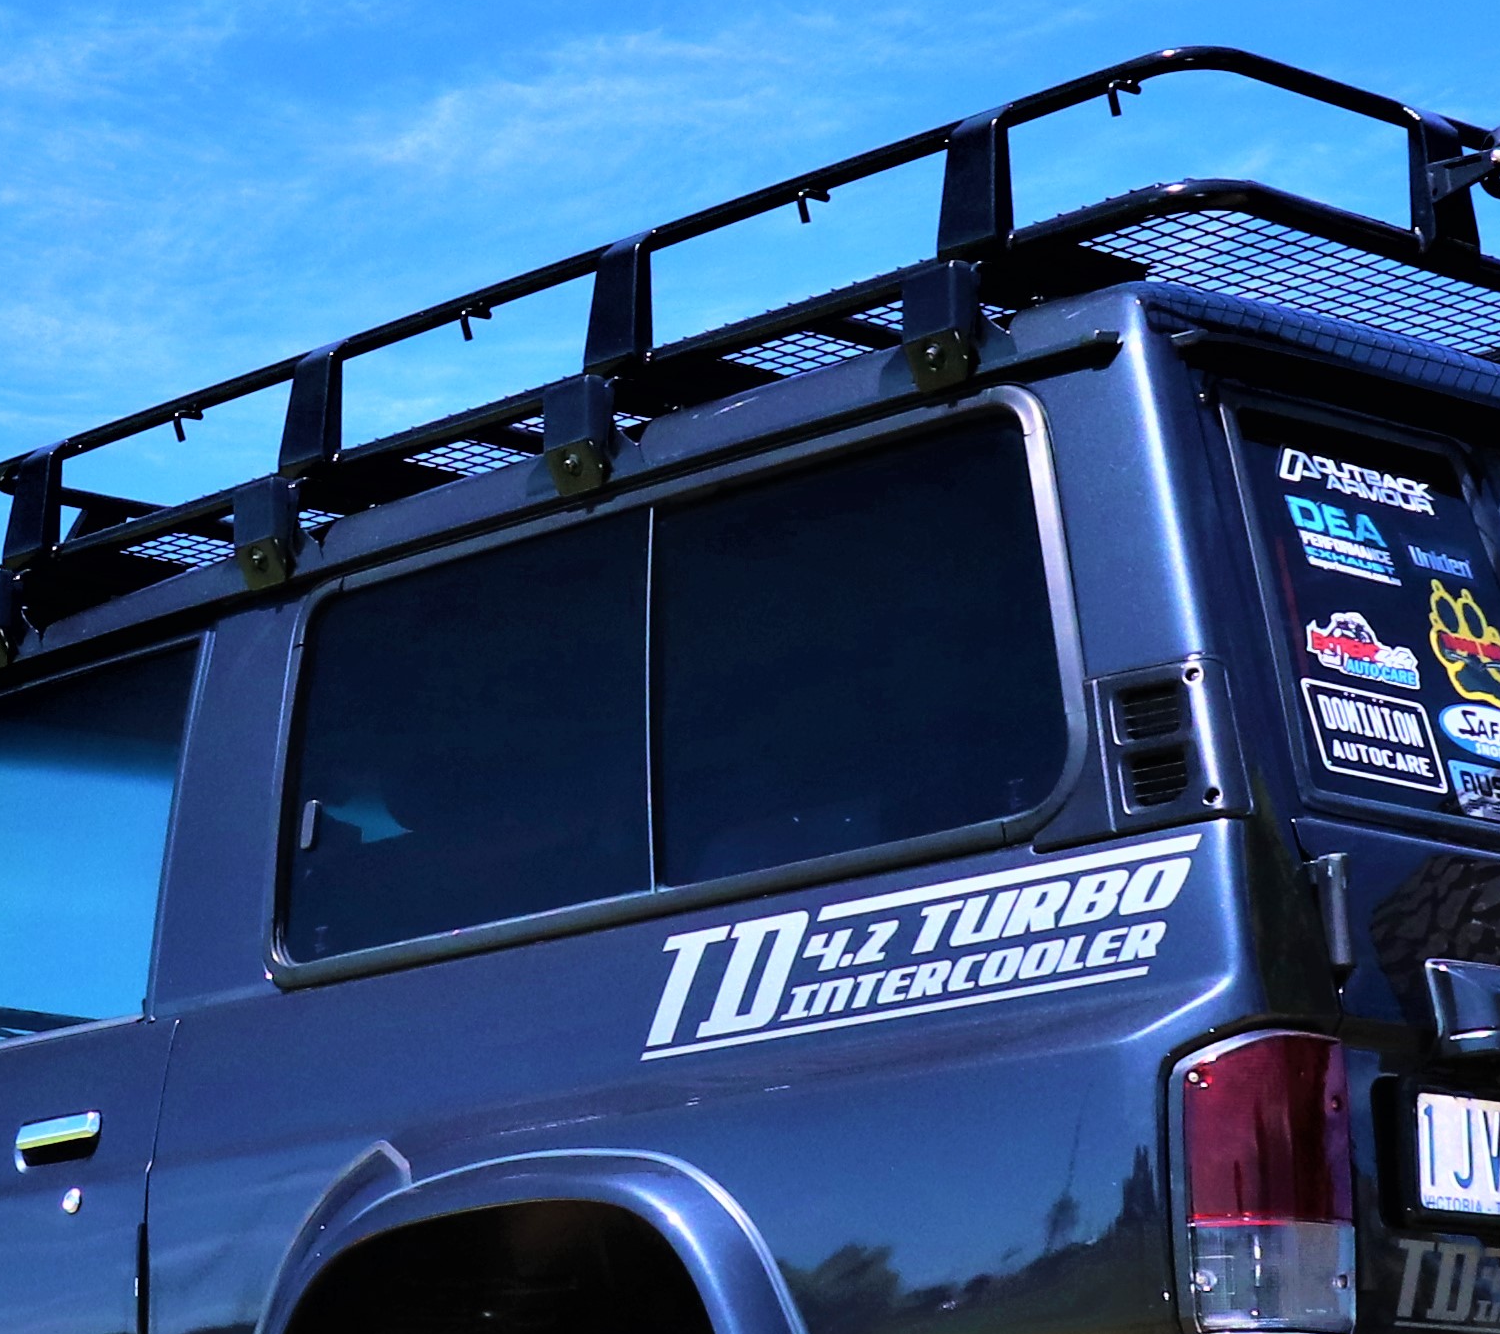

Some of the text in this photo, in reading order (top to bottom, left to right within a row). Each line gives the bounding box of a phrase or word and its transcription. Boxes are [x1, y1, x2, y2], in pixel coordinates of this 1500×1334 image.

[1312, 455, 1435, 501] OUTBACK
[1326, 475, 1435, 516] ARMOUR
[1284, 494, 1388, 548] DEA
[1298, 529, 1394, 566] PERFORMANCE
[1304, 546, 1395, 575] EXHAUST
[1408, 544, 1474, 579] Uniden
[1346, 659, 1417, 687] AUTO CARE
[1316, 693, 1425, 749] DOMINION
[1332, 738, 1434, 778] AUTOCARE
[802, 856, 1193, 973] 4.2 TURBO
[646, 910, 811, 1047] TD
[779, 921, 1168, 1023] INTERCOOLER
[1424, 1194, 1483, 1214] VICTORIA
[1397, 1238, 1481, 1322] TD
